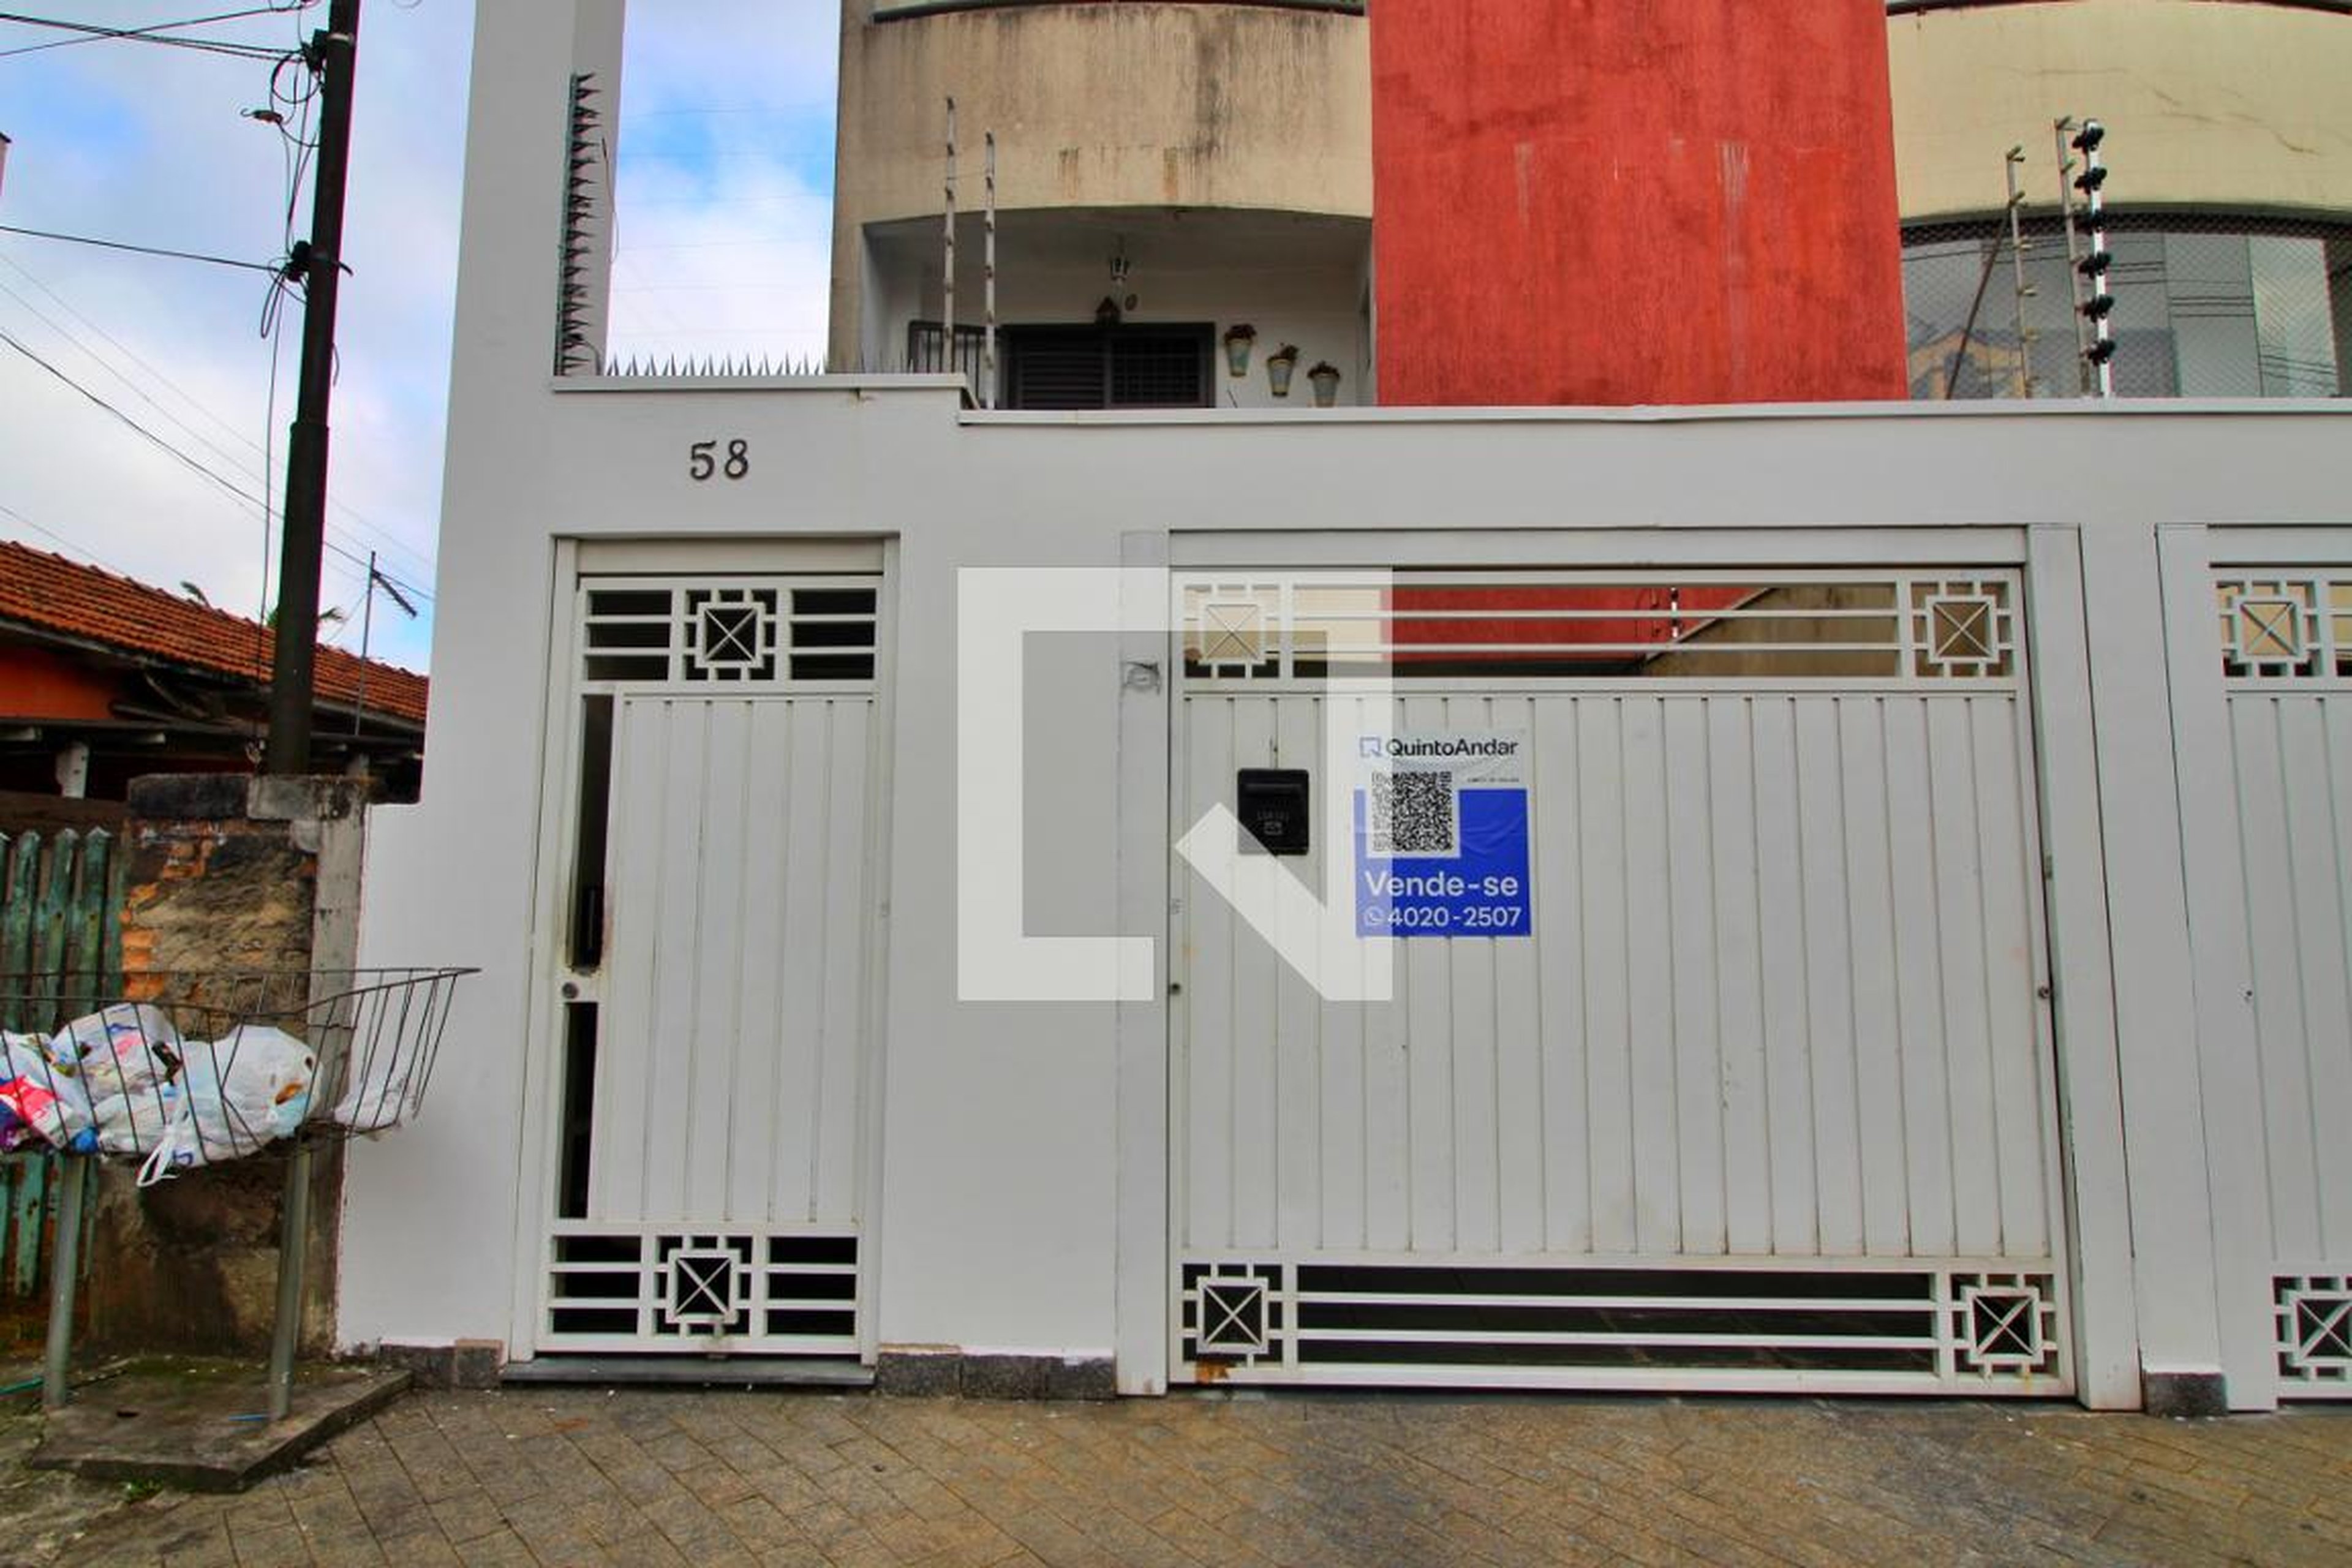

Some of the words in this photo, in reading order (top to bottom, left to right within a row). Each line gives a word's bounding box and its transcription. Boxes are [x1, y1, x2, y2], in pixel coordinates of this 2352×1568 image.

[690, 439, 748, 481] 58
[1386, 738, 1519, 756] QuintoAndar
[1364, 870, 1519, 897] Vende-se
[1387, 906, 1522, 927] 4020-2507
